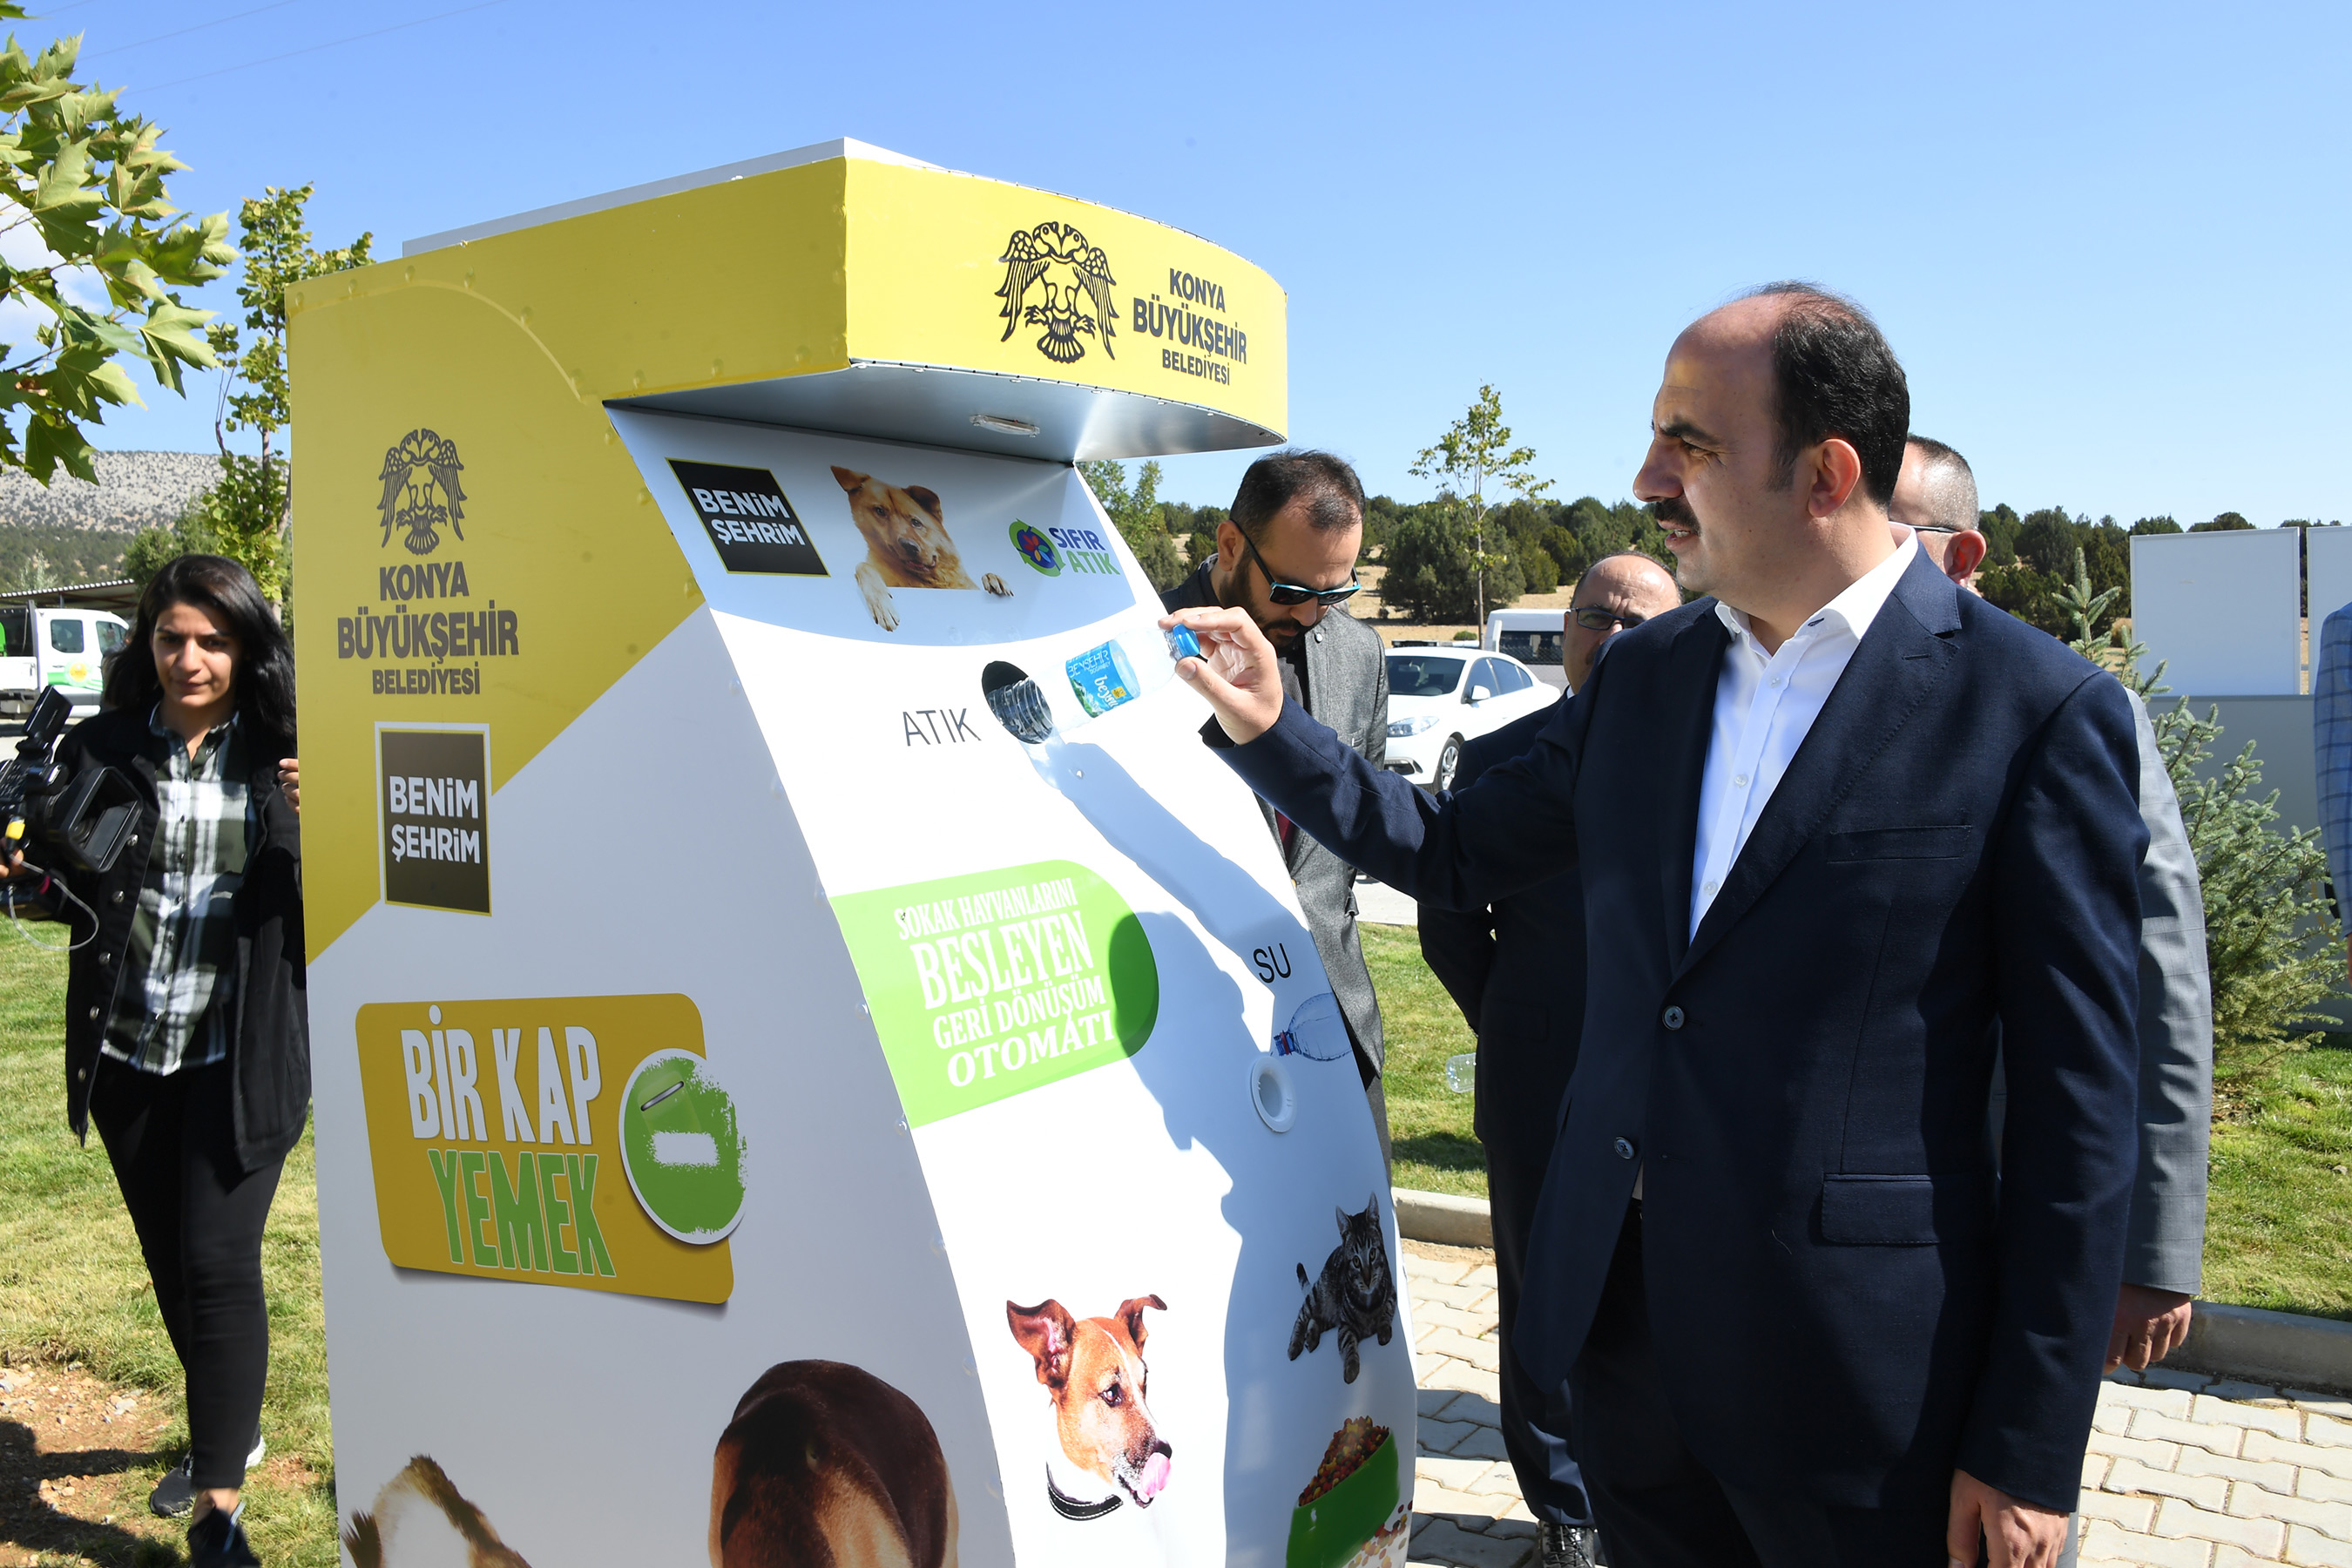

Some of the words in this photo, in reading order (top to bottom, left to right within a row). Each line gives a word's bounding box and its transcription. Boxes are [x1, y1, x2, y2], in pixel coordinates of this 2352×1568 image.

[1170, 268, 1226, 313] KONYA
[1133, 294, 1247, 364] BÜYÜKŞEHİR
[1163, 348, 1230, 386] BELEDİYESİ
[1048, 527, 1106, 551] SIFIR
[1065, 550, 1120, 575] ATIK
[379, 561, 470, 601] KONYA
[337, 599, 519, 664] BÜYÜKŞEHİR
[372, 661, 481, 695] BELEDİYESİ
[902, 708, 982, 747] ATIK
[894, 898, 961, 941] SOKAK
[957, 877, 1078, 929] HAYVANLARINI
[909, 910, 1094, 1010] BESLEYEN
[1252, 943, 1291, 983] SU
[933, 997, 993, 1050] GERİ
[993, 973, 1106, 1033] DÖNÜŞÜM
[400, 1004, 489, 1142] BİR
[491, 1025, 602, 1145] KAP
[947, 1010, 1115, 1087] OTOMATI
[426, 1148, 617, 1278] YEMEK
